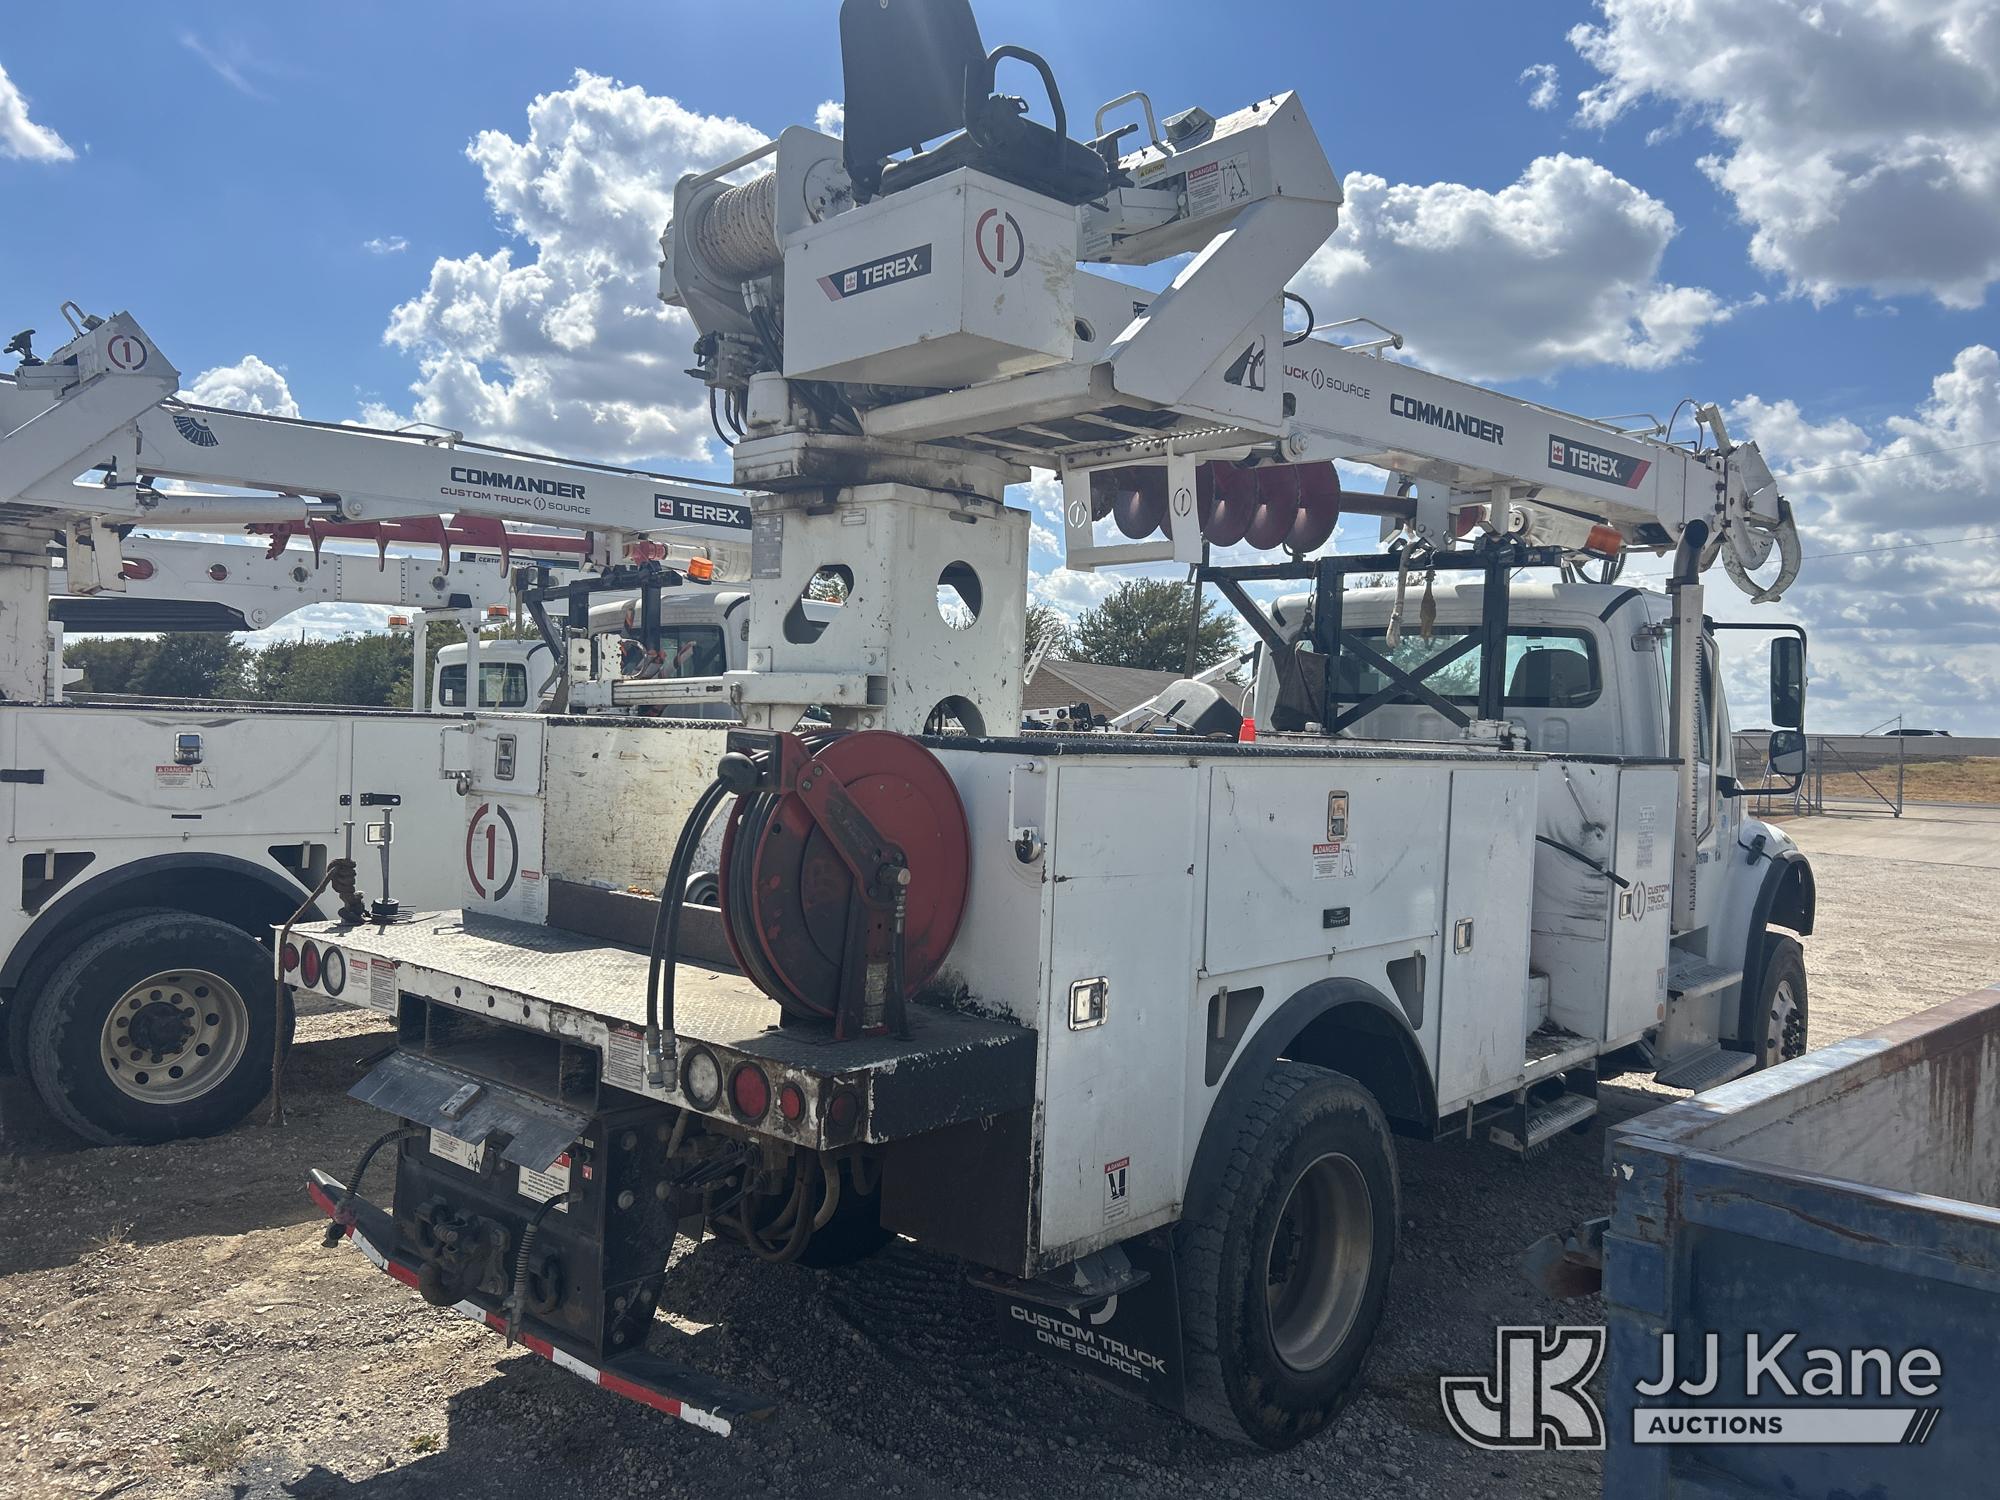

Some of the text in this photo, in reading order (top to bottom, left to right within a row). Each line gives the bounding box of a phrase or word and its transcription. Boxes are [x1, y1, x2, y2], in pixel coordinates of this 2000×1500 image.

[1195, 164, 1217, 178] DANGER
[862, 254, 919, 286] TEREX
[1326, 377, 1371, 400] SOURCE
[1390, 393, 1504, 446] COMMANDER
[1570, 447, 1618, 478] TEREX
[450, 467, 586, 500] COMMANDER
[440, 487, 491, 500] CUSTOM
[494, 494, 532, 506] TRUCK
[548, 502, 592, 515] SOURCE
[679, 502, 740, 524] TEREX
[1319, 845, 1339, 853] DANGER
[1648, 884, 1670, 895] CUSTOM
[1648, 894, 1664, 904] TRUCK
[1010, 1305, 1168, 1375] CUSTOM TRUCK
[1037, 1330, 1142, 1379] ONE SOURCE
